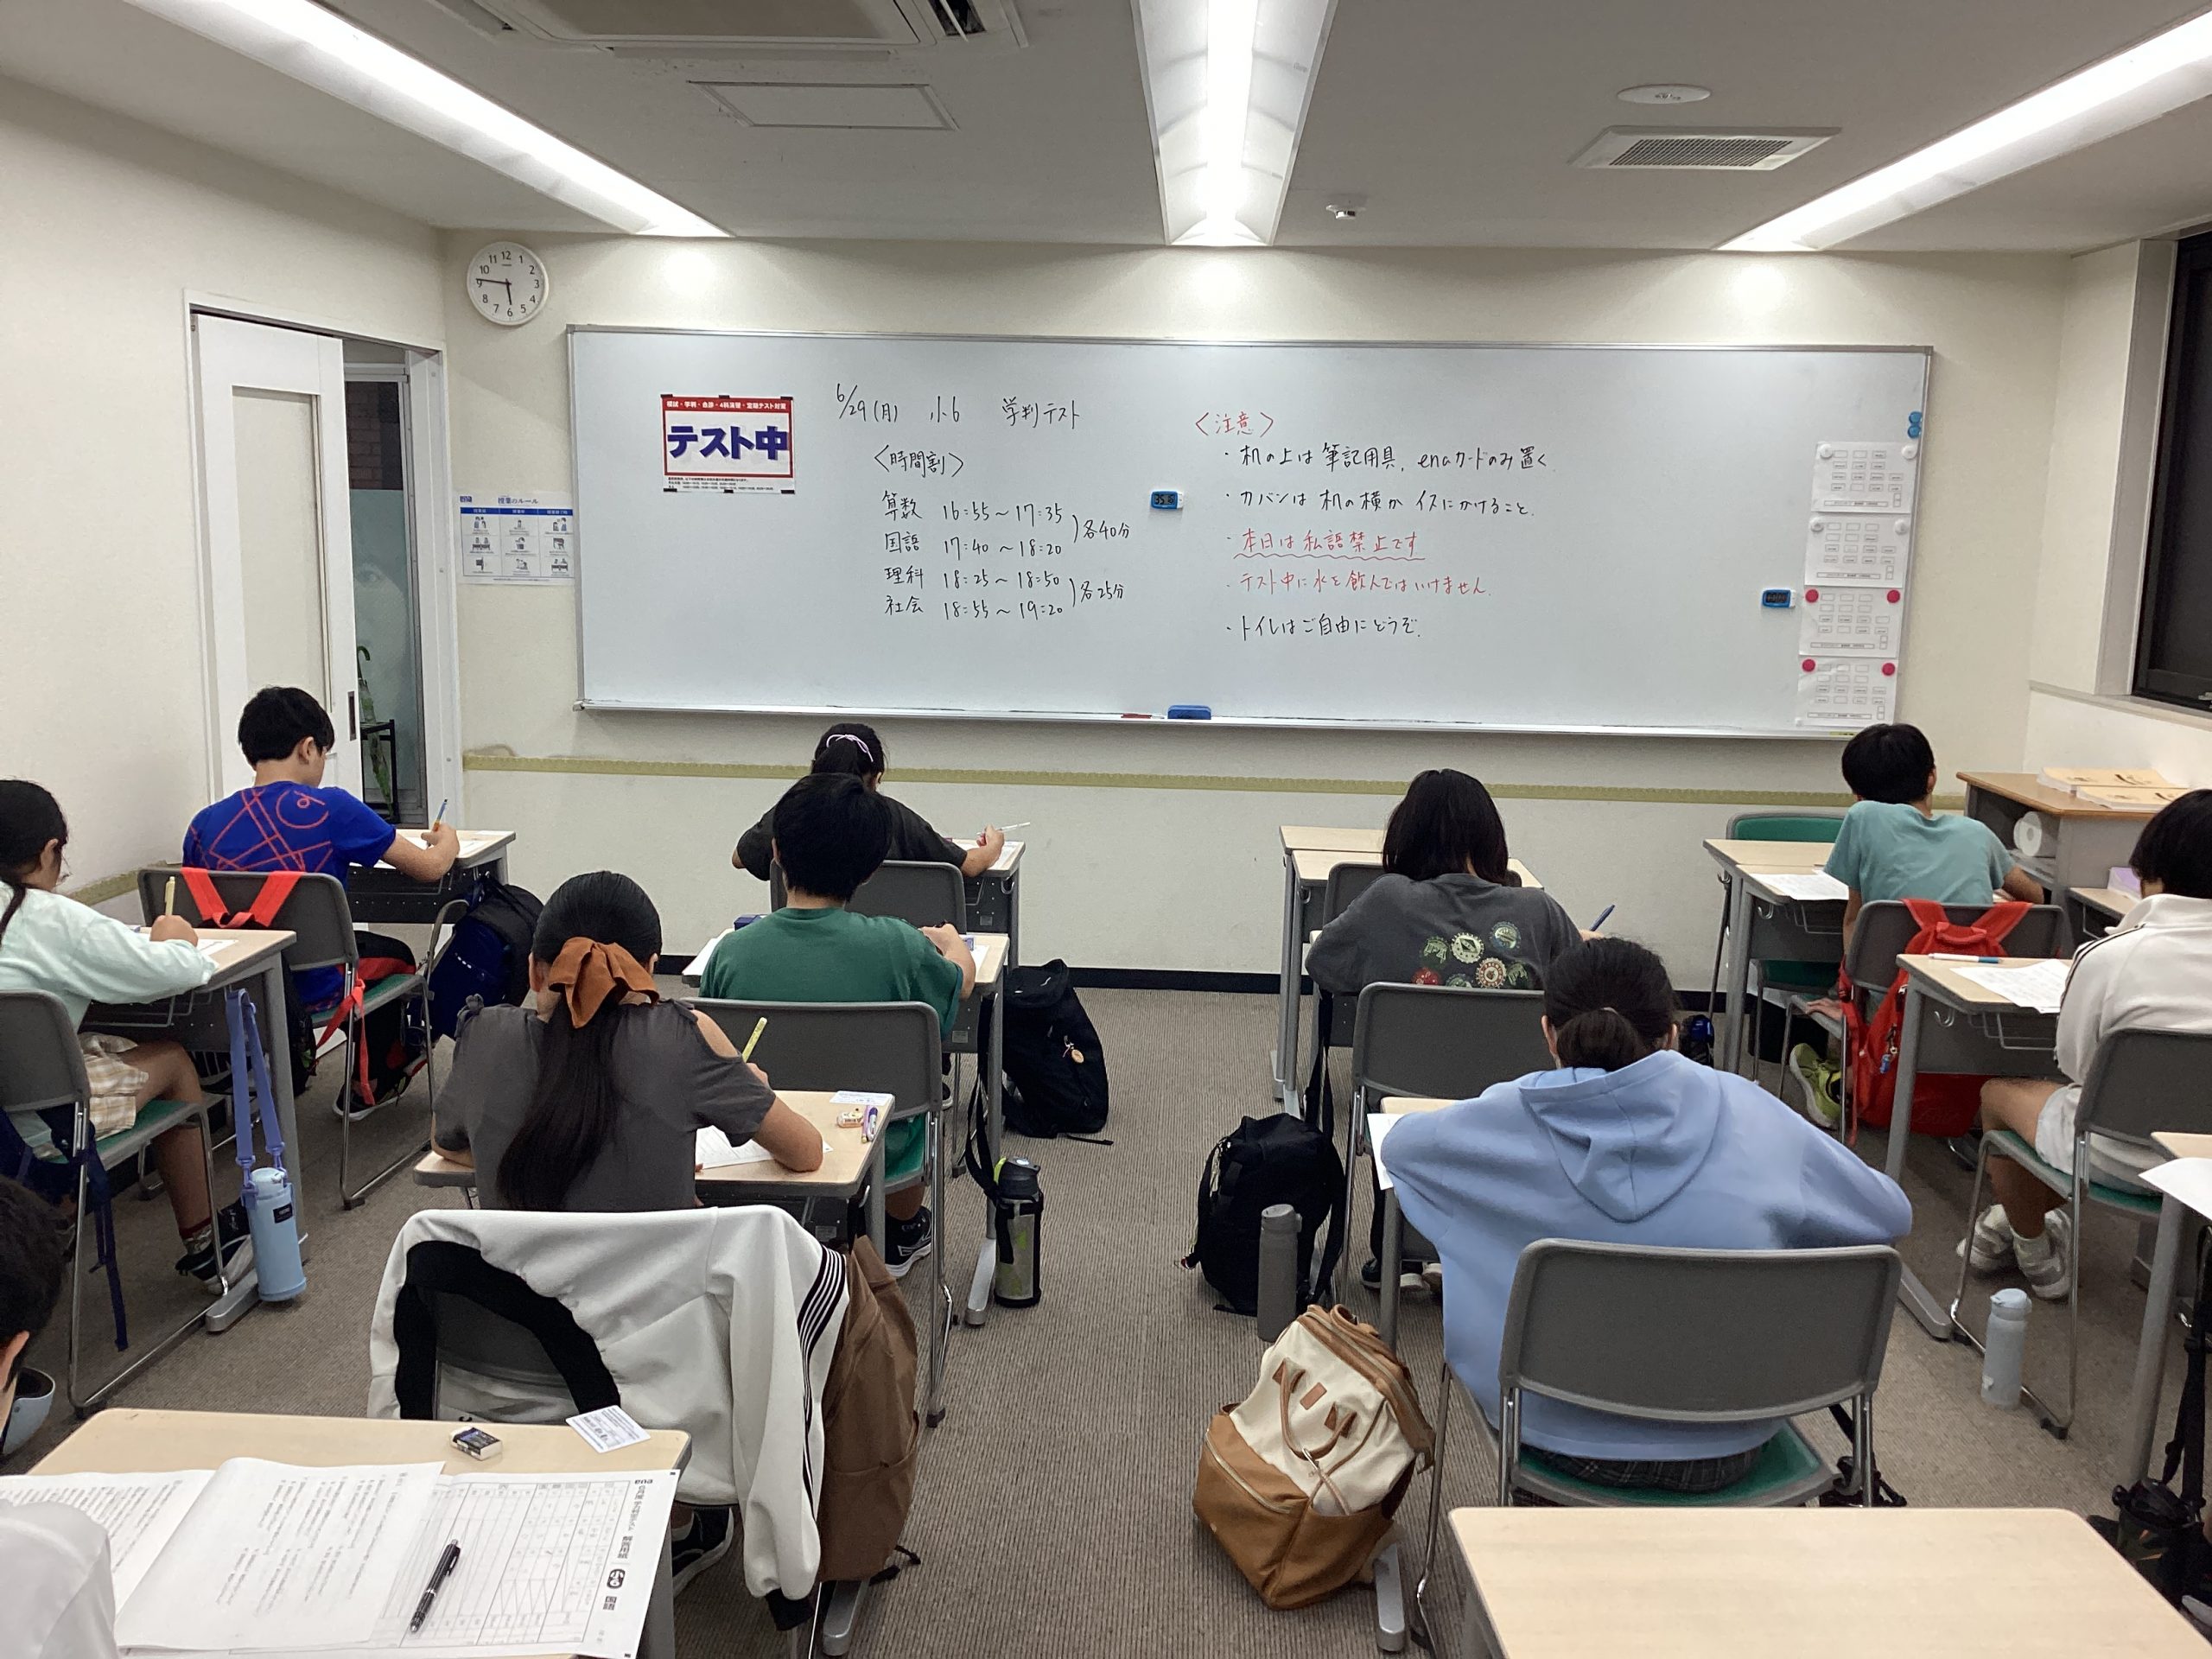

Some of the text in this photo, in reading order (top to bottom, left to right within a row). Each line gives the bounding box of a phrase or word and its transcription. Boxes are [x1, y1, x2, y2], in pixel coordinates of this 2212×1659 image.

[489, 255, 497, 264] 11
[501, 251, 512, 260] 12
[480, 264, 490, 275] 10
[529, 265, 535, 275] 2
[534, 280, 539, 289] 3
[482, 294, 488, 303] 8
[529, 295, 536, 303] 4
[493, 303, 499, 313] 7
[506, 308, 513, 317] 6
[520, 304, 526, 313] 5
[930, 396, 960, 423] 小6
[667, 425, 789, 461] テスト中
[881, 490, 923, 520] 算数
[884, 531, 920, 554] 国語
[883, 564, 924, 589] 理科
[883, 594, 925, 616] 社会
